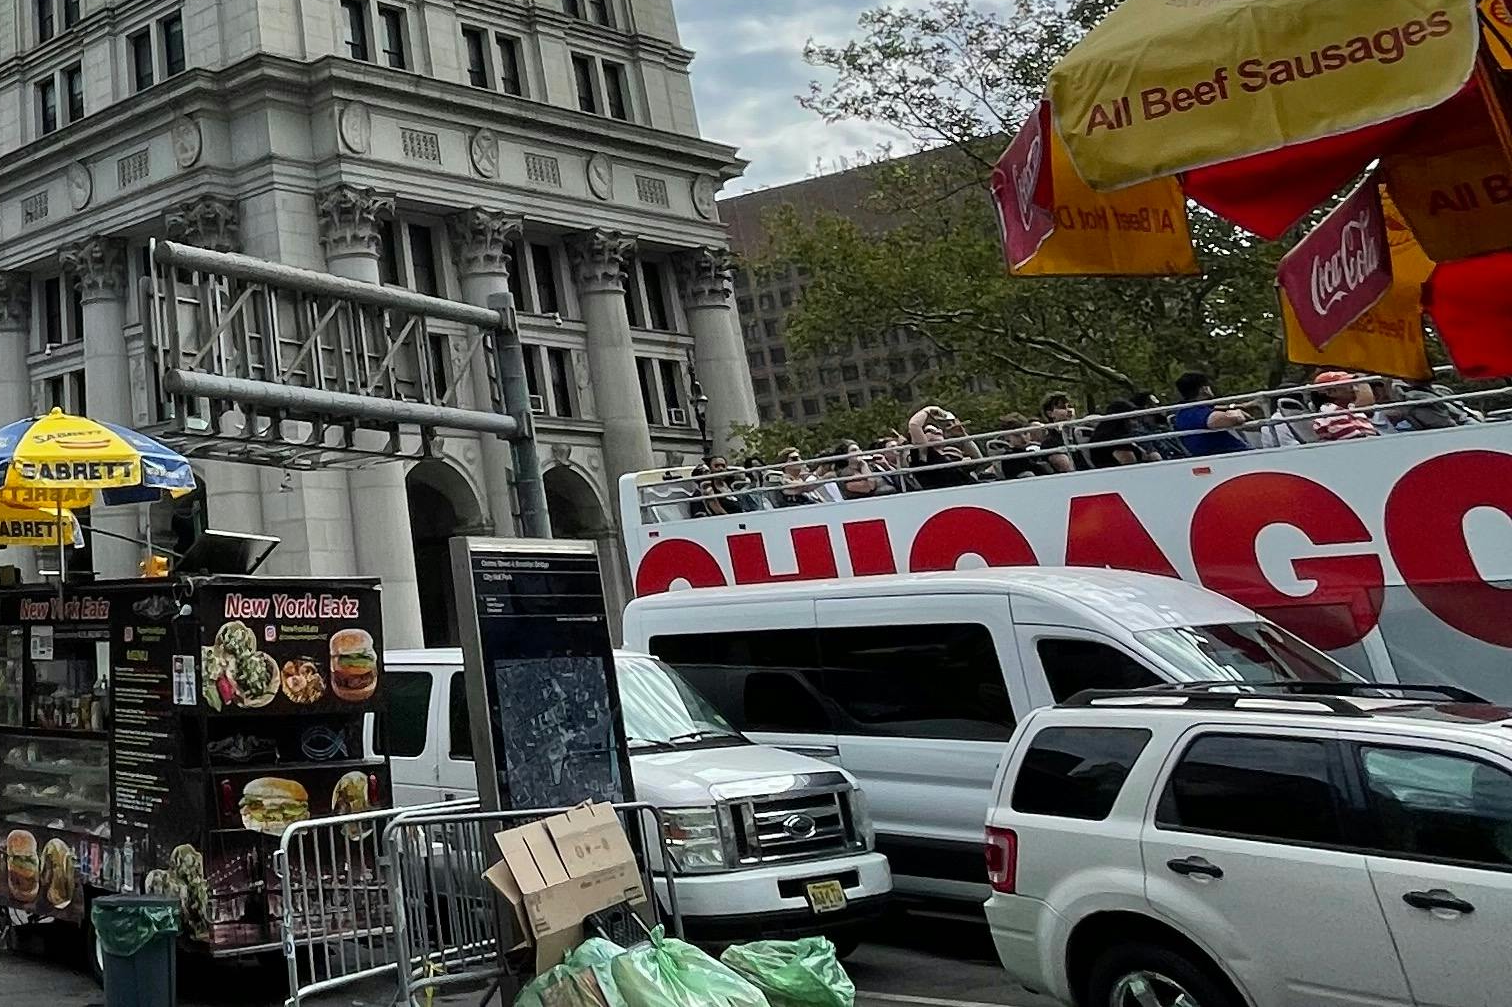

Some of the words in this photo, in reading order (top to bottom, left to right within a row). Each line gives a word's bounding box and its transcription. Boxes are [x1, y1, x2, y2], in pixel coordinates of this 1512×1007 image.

[1086, 96, 1133, 136] All
[1140, 66, 1229, 121] Beef
[1237, 10, 1453, 93] Sausages
[1428, 181, 1480, 216] All
[21, 460, 134, 482] SABRETT
[20, 598, 49, 620] New
[50, 596, 80, 621] Yrk
[224, 593, 270, 619] New
[272, 593, 317, 619] York
[319, 594, 360, 619] Eatz
